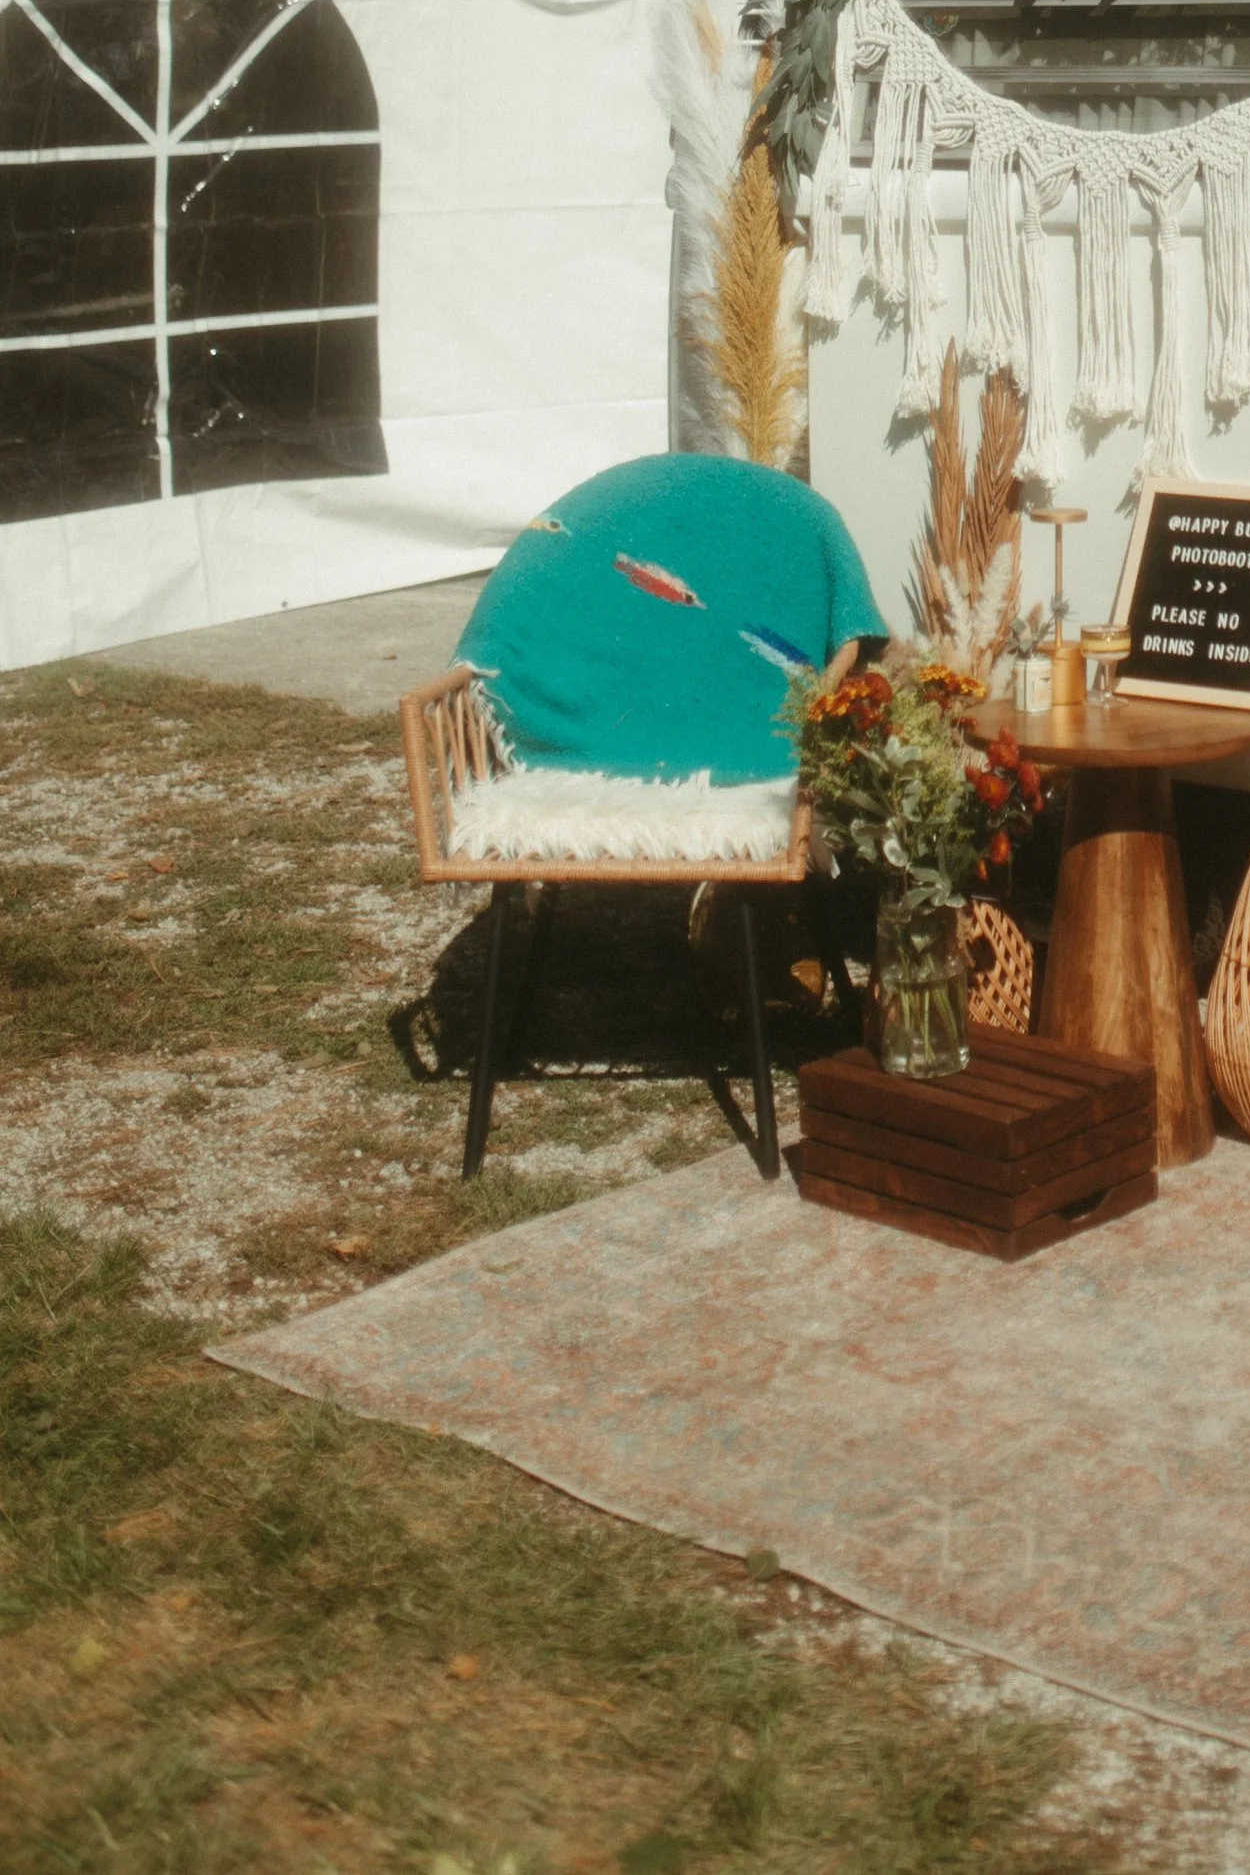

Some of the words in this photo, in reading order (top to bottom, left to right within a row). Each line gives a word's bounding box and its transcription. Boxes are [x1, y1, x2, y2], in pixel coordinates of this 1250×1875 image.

[1168, 515, 1229, 536] @HAPPY
[1151, 604, 1207, 627] PLEASE
[1217, 612, 1240, 630] NO
[1142, 634, 1195, 657] DRINKS
